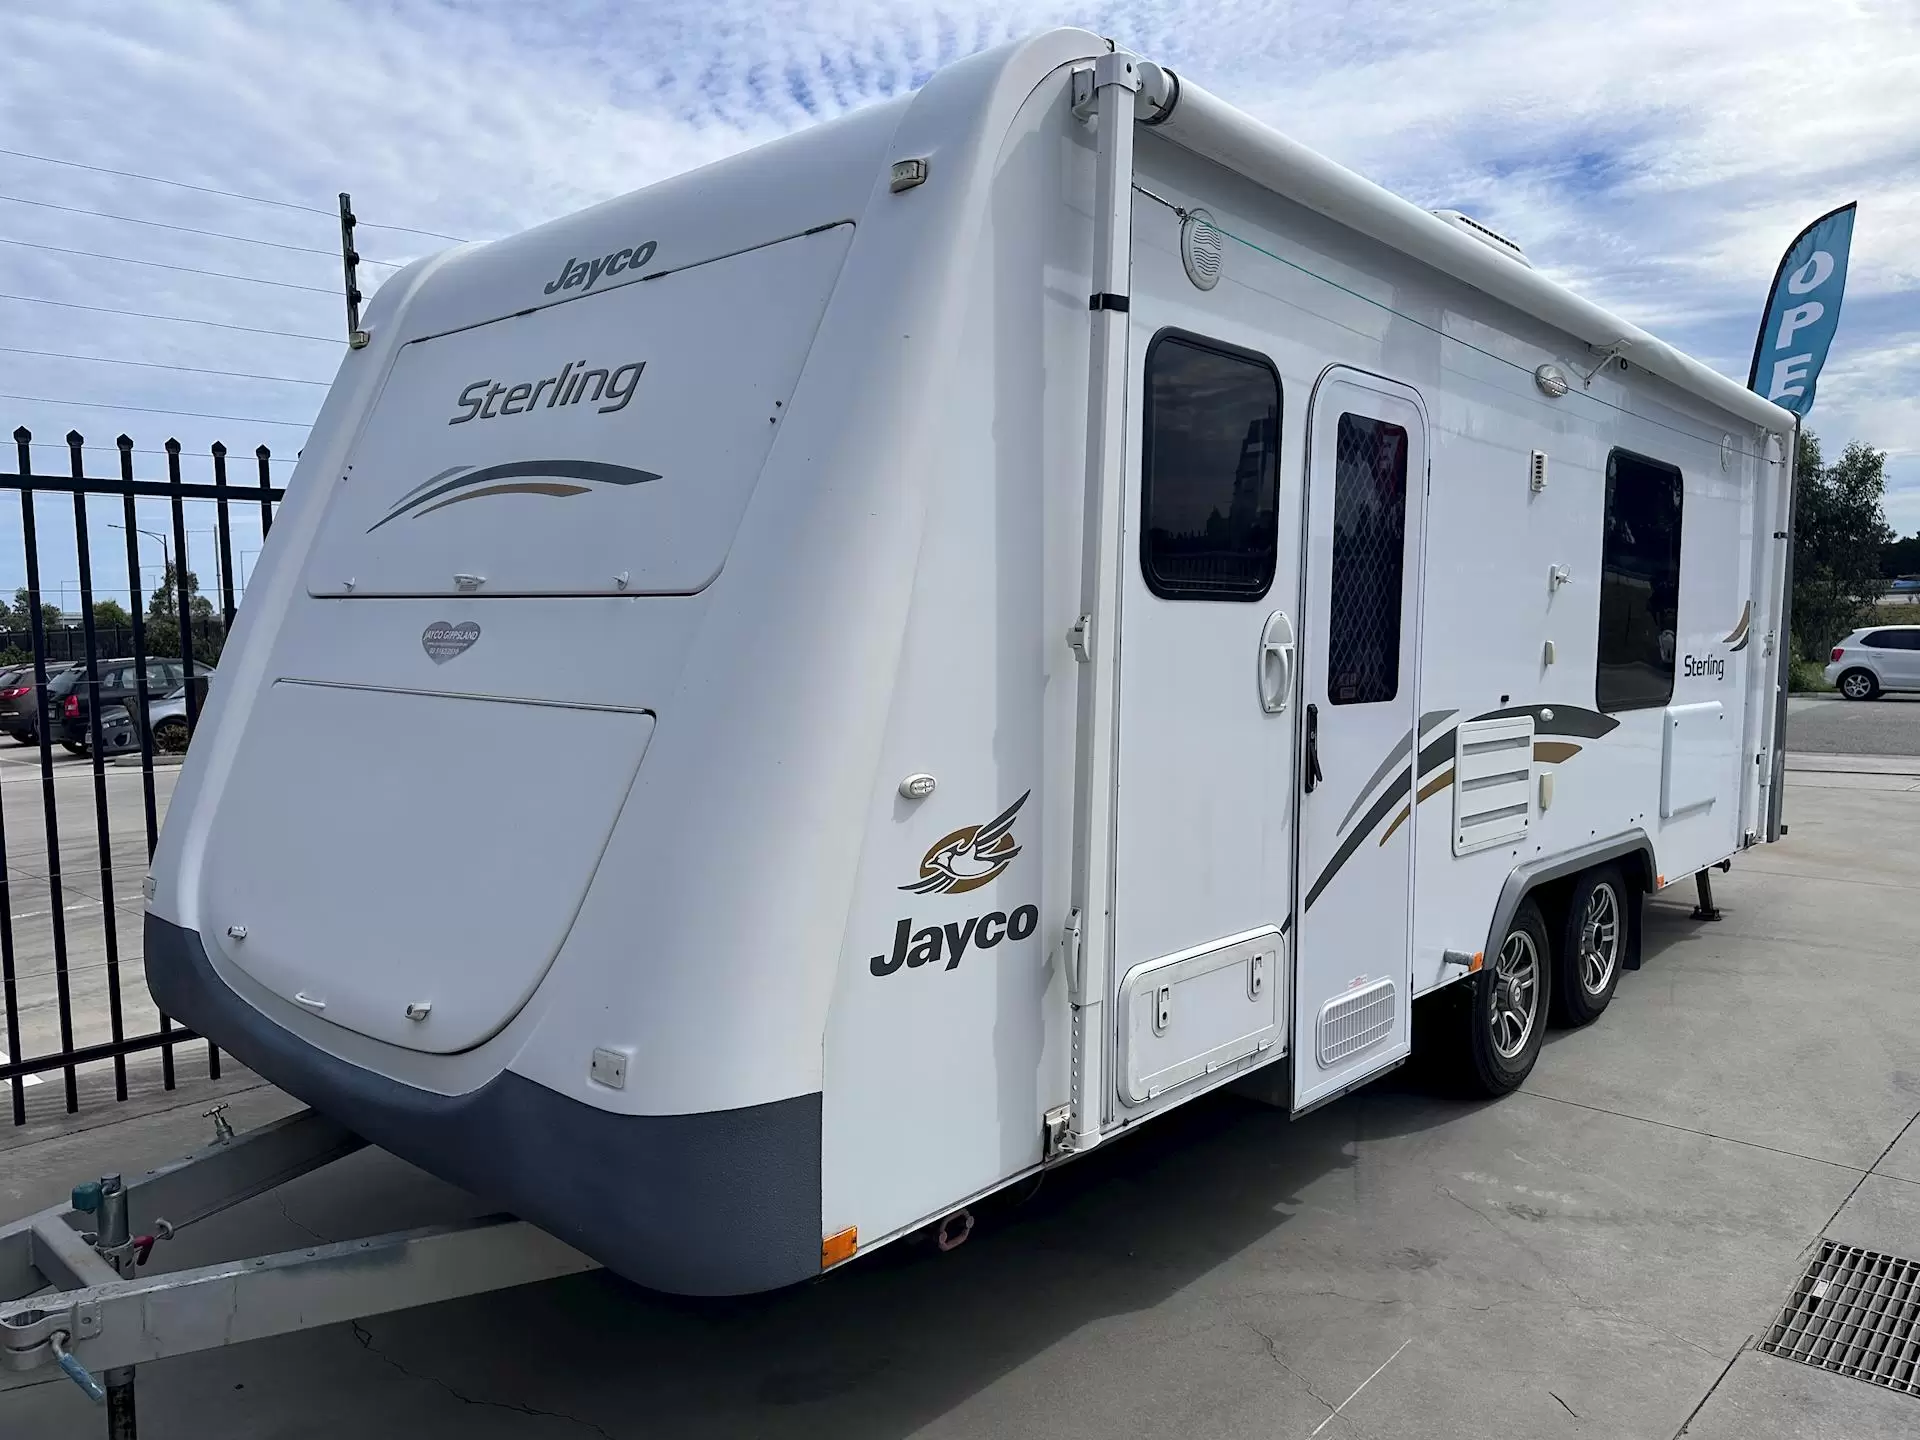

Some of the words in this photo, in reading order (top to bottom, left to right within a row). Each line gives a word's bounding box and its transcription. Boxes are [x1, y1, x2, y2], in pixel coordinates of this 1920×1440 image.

[543, 240, 658, 295] Jayco
[1767, 250, 1835, 400] OPE
[448, 359, 647, 426] Sterling
[423, 630, 443, 640] JAYCO
[443, 630, 478, 640] GIPPSLAND
[1684, 654, 1724, 681] Sterling
[869, 904, 1039, 977] Jayco
